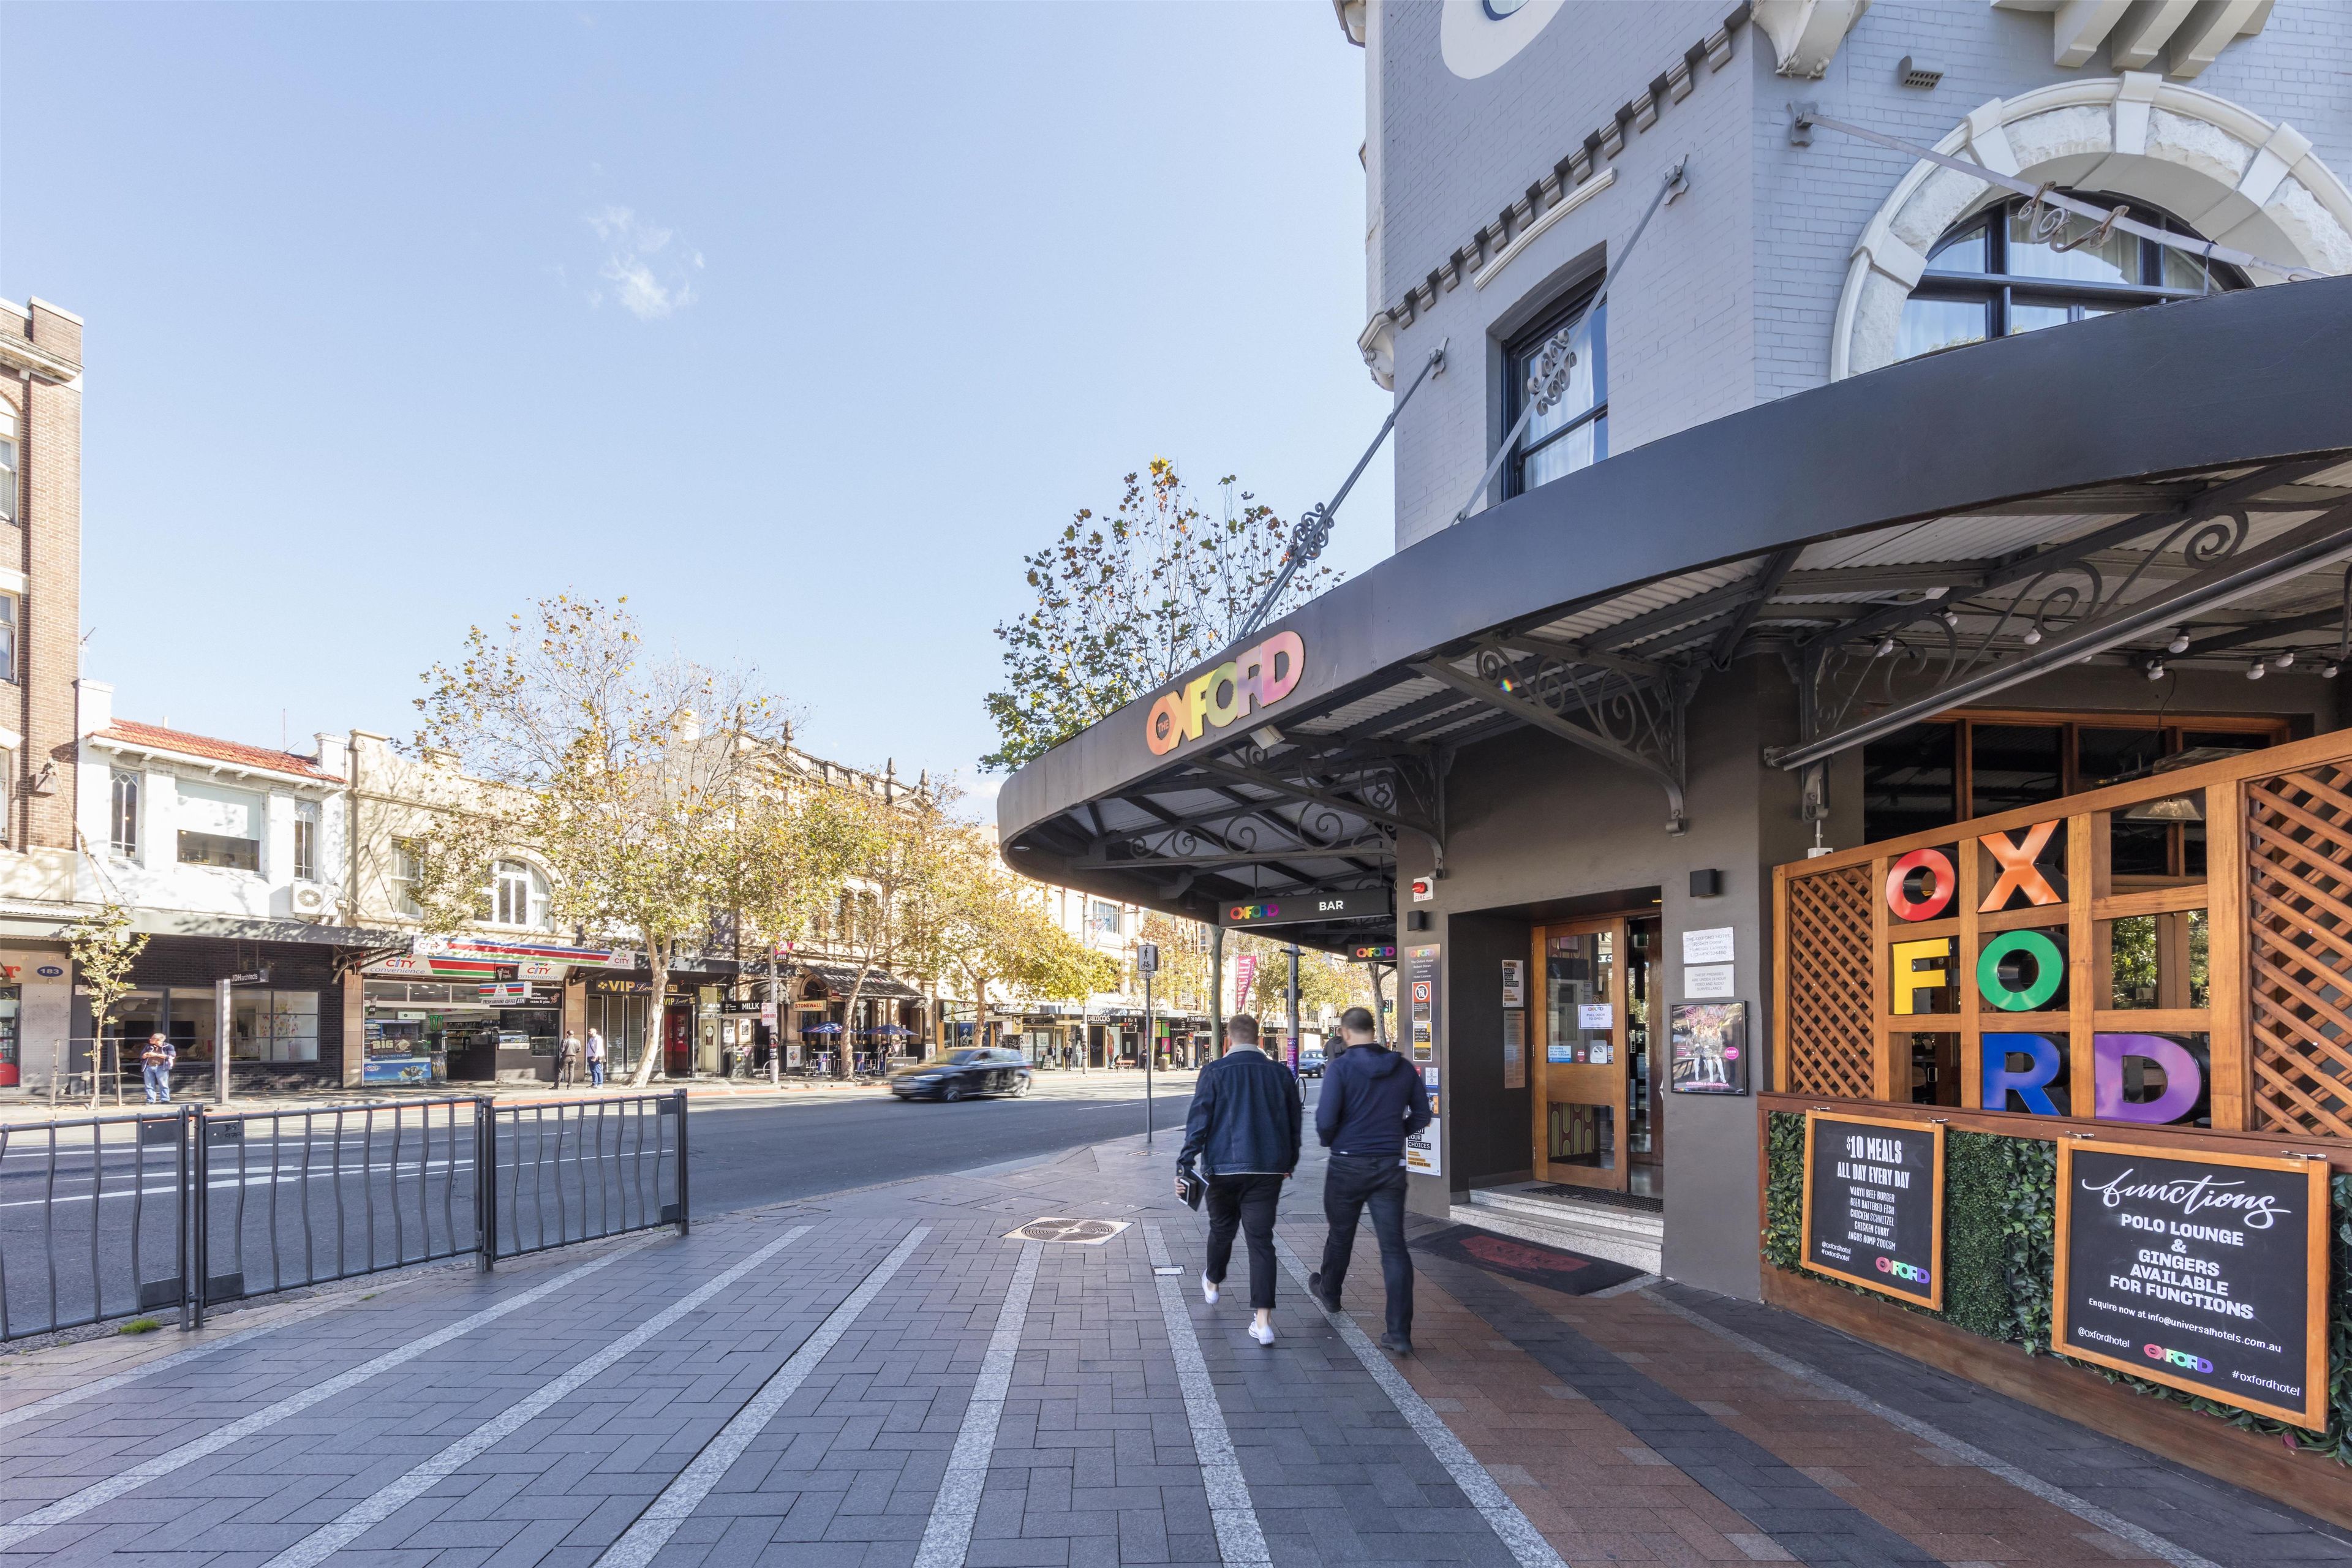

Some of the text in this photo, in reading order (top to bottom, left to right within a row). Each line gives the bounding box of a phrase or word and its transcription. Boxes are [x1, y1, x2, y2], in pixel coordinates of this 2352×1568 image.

[1146, 631, 1305, 756] OXFORD
[1157, 720, 1170, 734] THE
[1230, 904, 1279, 919] OXFORD
[1319, 900, 1343, 911] BAR
[1356, 946, 1395, 958] OXFORD
[608, 980, 654, 992] VIP Lou
[1685, 1006, 1727, 1019] SLAY
[372, 1039, 394, 1049] BIG
[1846, 1136, 1902, 1164] $10 MEALS
[1837, 1161, 1910, 1189] ALL DAY EVERY DAY
[1850, 1186, 1895, 1203] WAGYU BEEF BURGER
[2082, 1168, 2291, 1229] functions
[1850, 1197, 1894, 1215] BEER BATTERED FISH
[1850, 1208, 1894, 1226] CHICKEN SCHNITZEL
[1854, 1221, 1890, 1237] CHICKEN CURRY
[2121, 1213, 2244, 1246] POLO LOUNGE
[1822, 1241, 1851, 1255] @oxfordhotel
[1847, 1231, 1896, 1251] ANGUS RUMP 200GSM
[2171, 1238, 2187, 1254] &
[1821, 1249, 1850, 1262] #oxfordhotel
[2138, 1249, 2220, 1277] GINGERS
[1875, 1256, 1931, 1284] OXFORD
[2130, 1264, 2229, 1297] AVAILABLE
[2109, 1275, 2254, 1319] FOR FUNCTIONS
[2089, 1298, 2282, 1353] Enquire now at info@universalhotels.com.au
[2078, 1327, 2130, 1348] @oxfordhotel
[2144, 1343, 2214, 1374] OXFORD
[2231, 1370, 2300, 1397] #oxfordhotel
